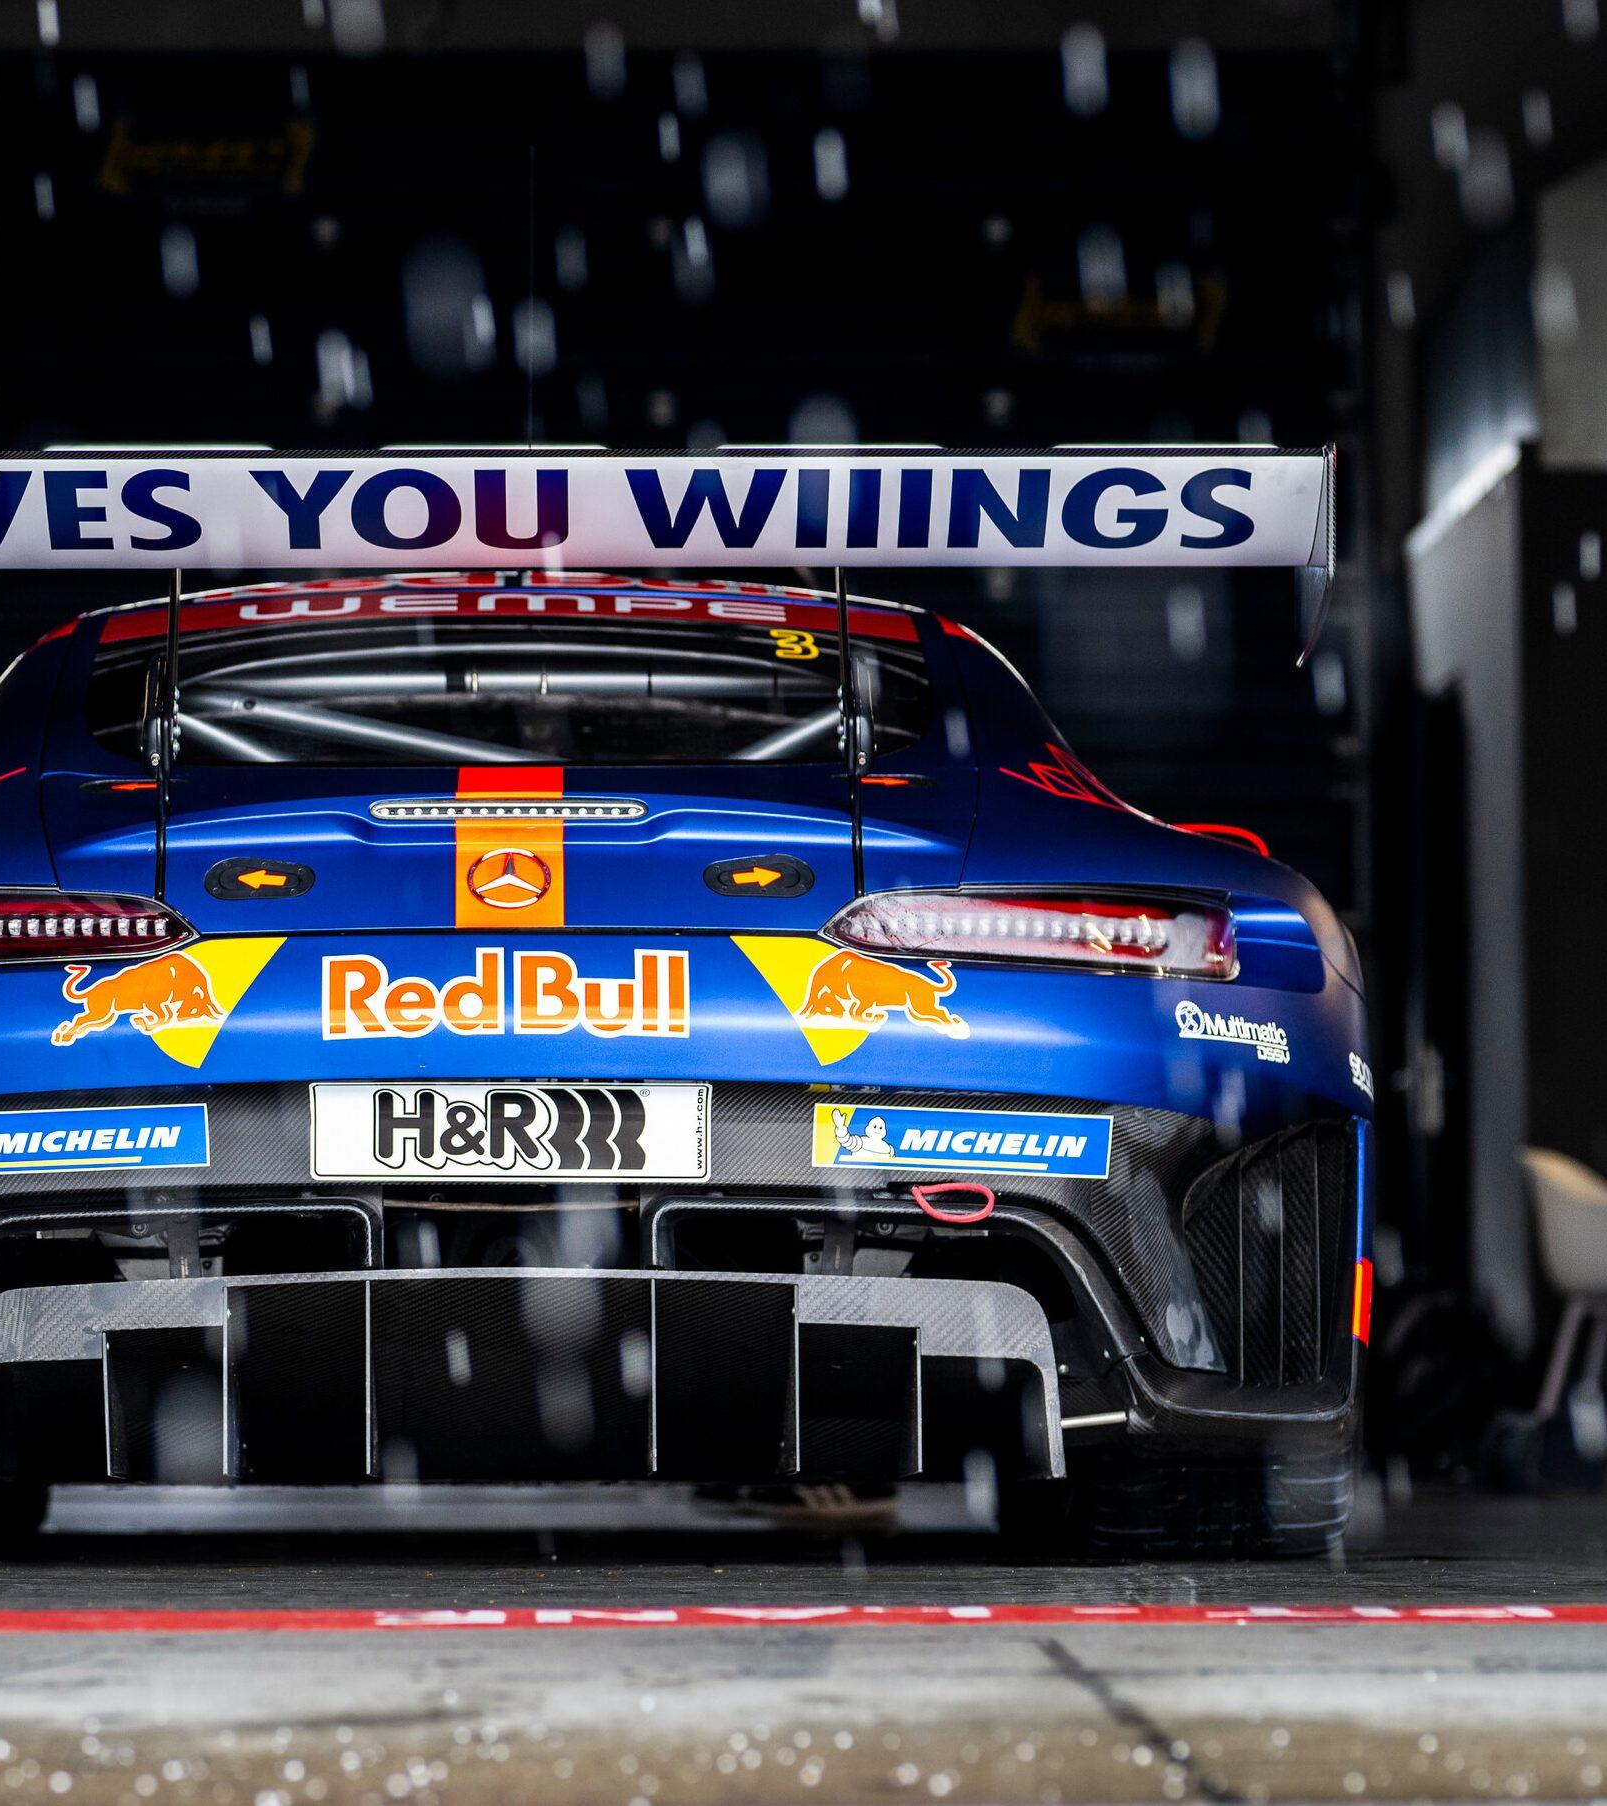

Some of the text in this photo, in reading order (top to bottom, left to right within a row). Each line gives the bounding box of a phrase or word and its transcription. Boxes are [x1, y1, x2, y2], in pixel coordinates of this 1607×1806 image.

[248, 467, 569, 552] YOU
[624, 467, 1256, 551] WIIINGS
[239, 592, 787, 622] WEMPE
[322, 947, 690, 1040] Red Bull
[1203, 1013, 1288, 1046] Multimatic
[372, 1088, 559, 1170] H&R
[695, 1088, 704, 1170] www.h-r.com
[899, 1128, 1088, 1158] MICHELIN
